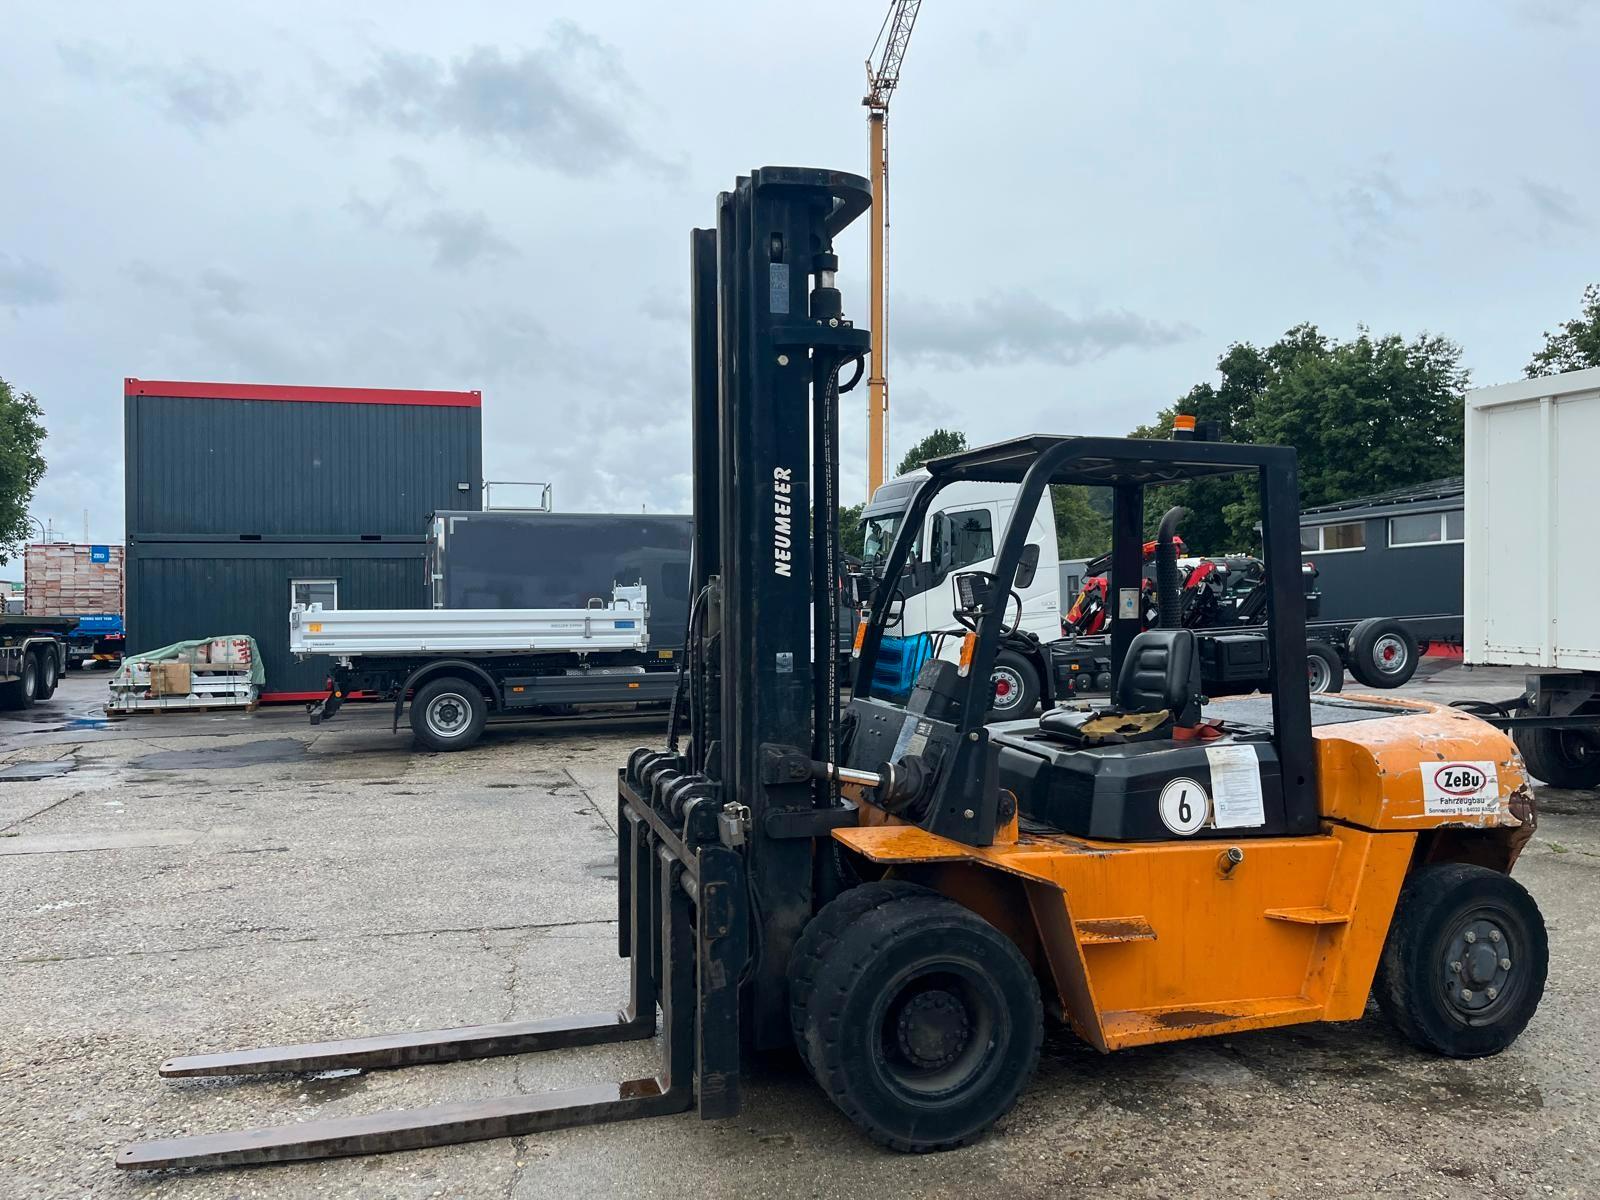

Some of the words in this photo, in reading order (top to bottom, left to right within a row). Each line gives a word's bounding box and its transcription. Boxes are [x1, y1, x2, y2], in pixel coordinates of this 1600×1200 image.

[773, 466, 792, 577] NEUMEIER
[1444, 771, 1480, 788] ZeBu
[1178, 789, 1192, 824] 6
[1439, 797, 1485, 805] Fahrzeugbau
